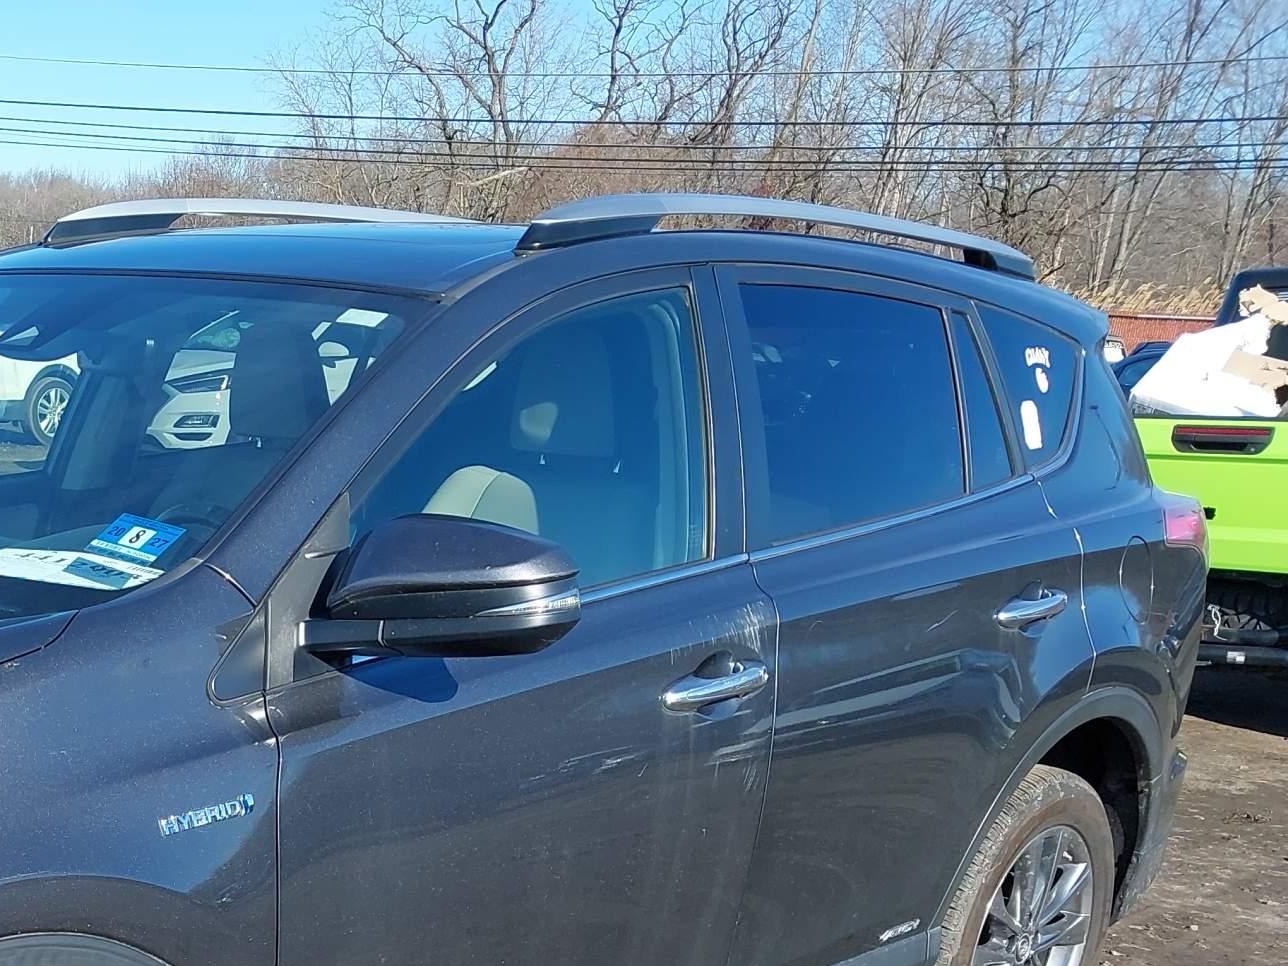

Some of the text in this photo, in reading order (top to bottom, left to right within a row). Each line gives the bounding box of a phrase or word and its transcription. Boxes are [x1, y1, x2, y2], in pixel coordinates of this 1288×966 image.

[107, 526, 170, 549] 20 8 27
[158, 800, 242, 838] HYBRID
